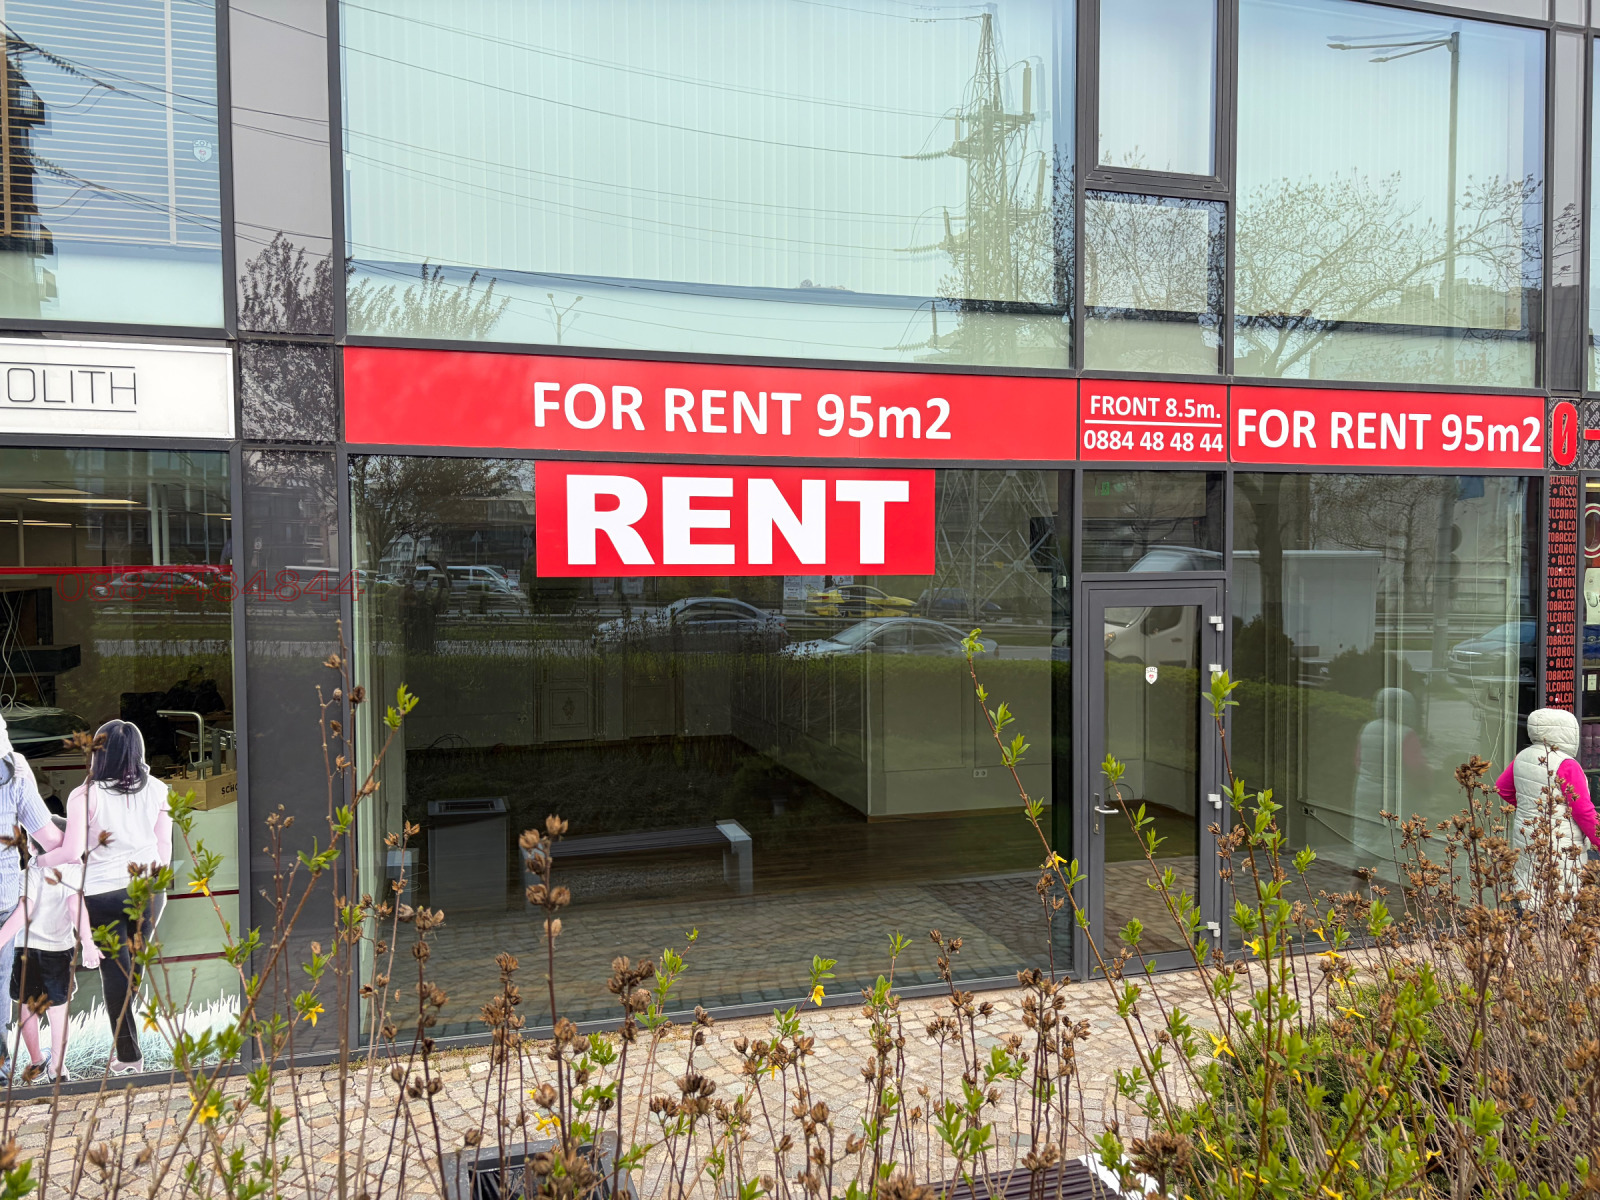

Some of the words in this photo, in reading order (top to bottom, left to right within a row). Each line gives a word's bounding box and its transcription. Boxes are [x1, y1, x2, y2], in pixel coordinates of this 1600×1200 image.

[7, 367, 137, 405] OLITH
[533, 381, 646, 431] FOR
[665, 388, 803, 436] RENT
[817, 394, 952, 440] 95m2
[1091, 395, 1161, 417] FRONT
[1166, 397, 1221, 419] 8.5m.
[1084, 430, 1135, 450] 0884
[1140, 431, 1165, 451] 48
[1170, 432, 1195, 452] 48
[1200, 433, 1224, 453] 44
[1238, 408, 1317, 449] FOR
[1331, 411, 1432, 451] RENT
[1442, 414, 1542, 453] 95m2
[566, 474, 910, 565] RENT
